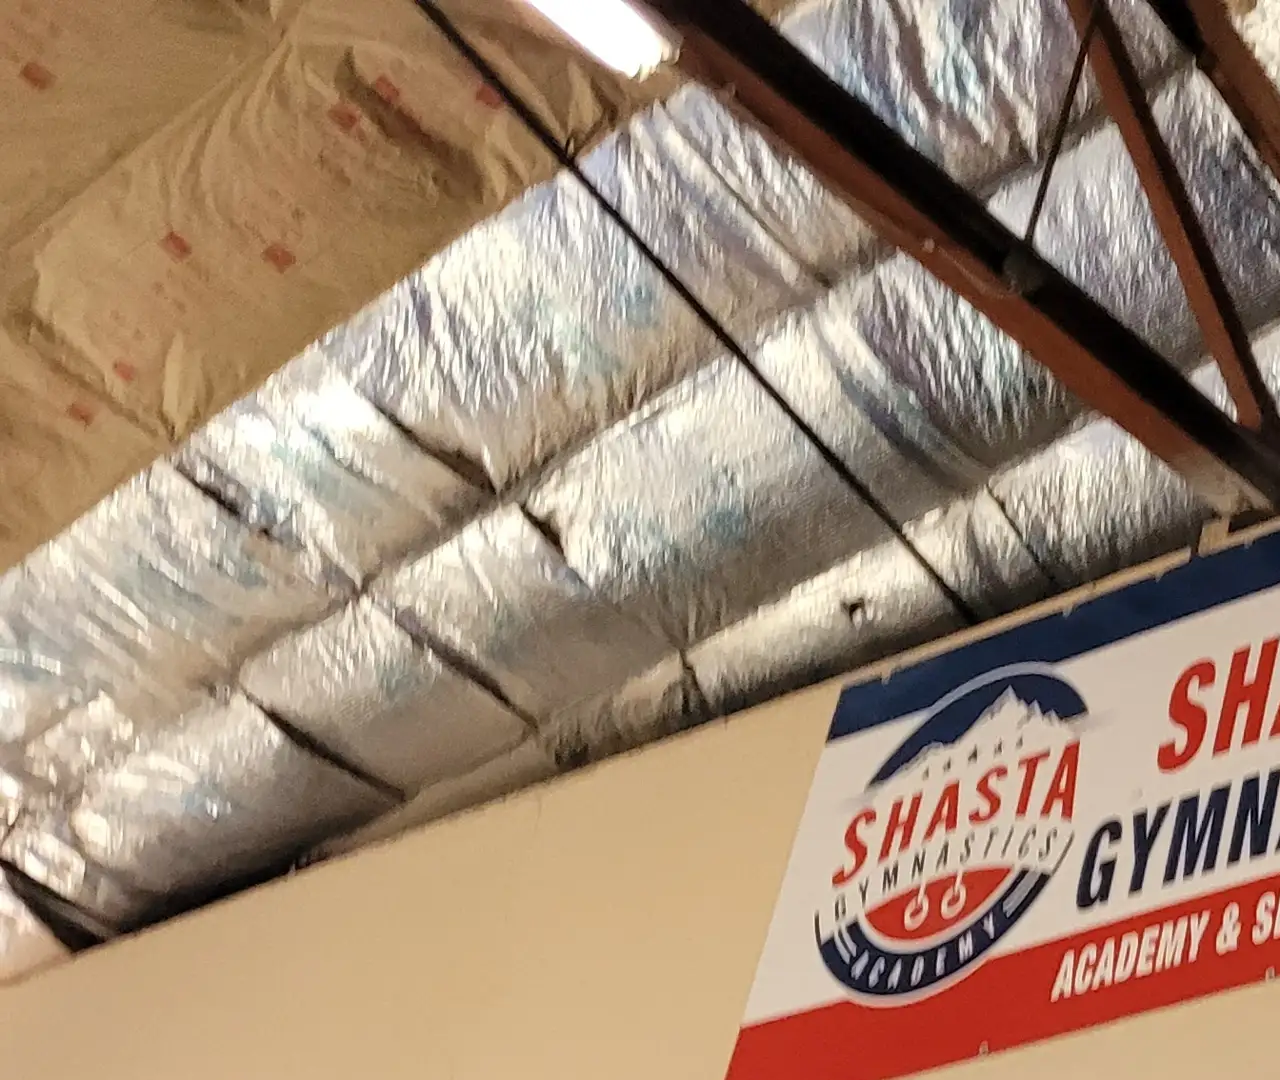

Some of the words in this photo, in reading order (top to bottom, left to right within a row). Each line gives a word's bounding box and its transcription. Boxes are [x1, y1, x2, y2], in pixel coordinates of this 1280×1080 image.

[831, 738, 1081, 888] SHASTA
[833, 823, 1060, 922] GYMNASTICS
[1050, 909, 1212, 1003] ACADEMY
[1215, 902, 1242, 956] &
